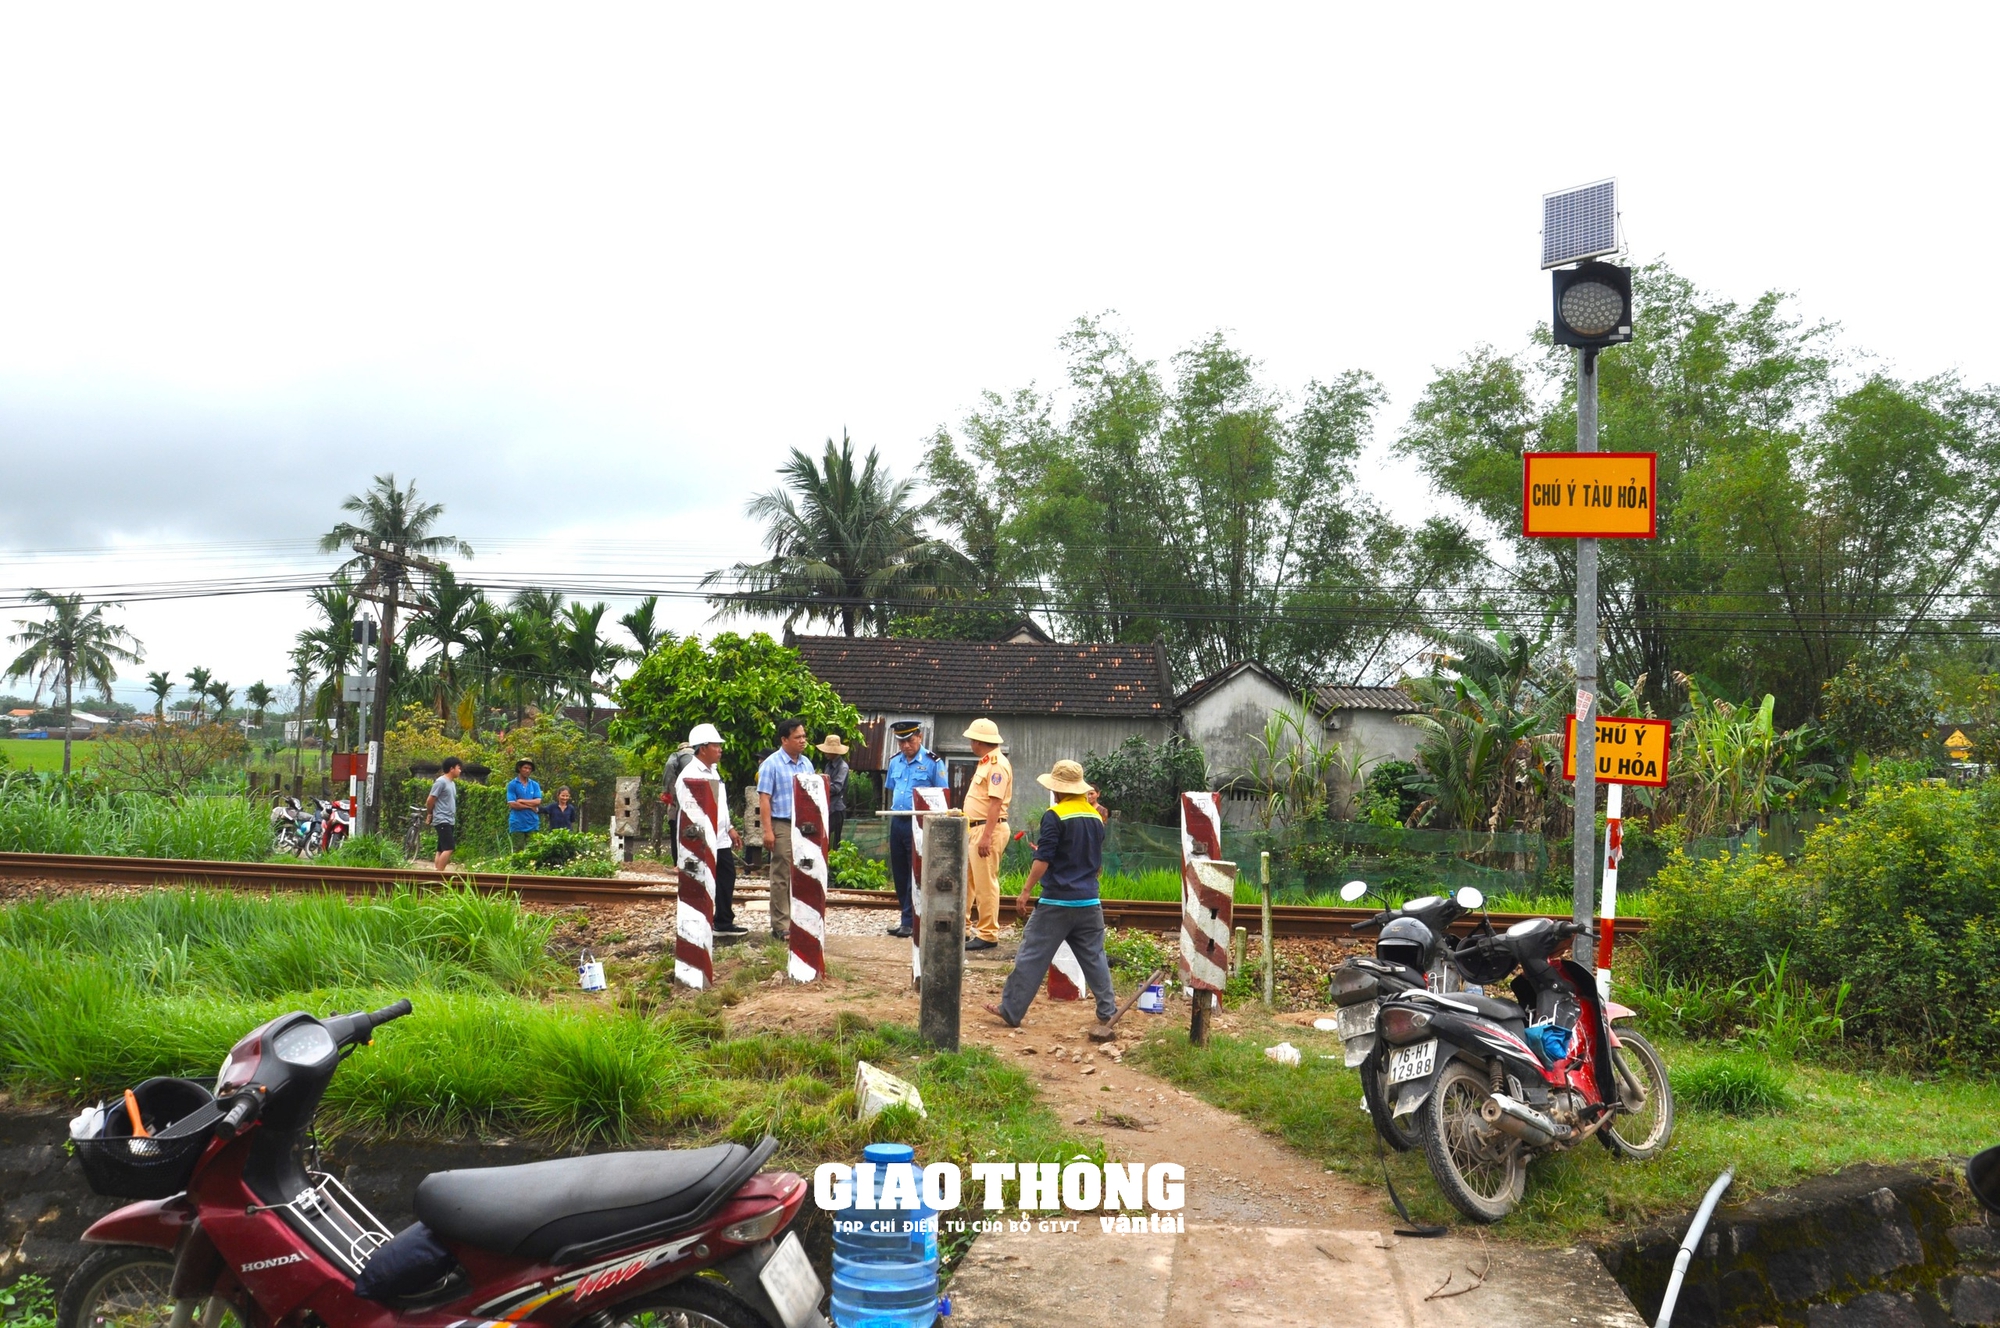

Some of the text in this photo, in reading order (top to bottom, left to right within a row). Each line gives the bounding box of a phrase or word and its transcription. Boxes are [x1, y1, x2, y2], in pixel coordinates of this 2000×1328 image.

[1532, 477, 1648, 509] CHÚ Ý TÀU HỎA
[1634, 725, 1647, 746] Ý
[1618, 751, 1657, 777] HỎA
[1392, 1058, 1432, 1082] 129.88
[241, 1253, 302, 1272] HONDA
